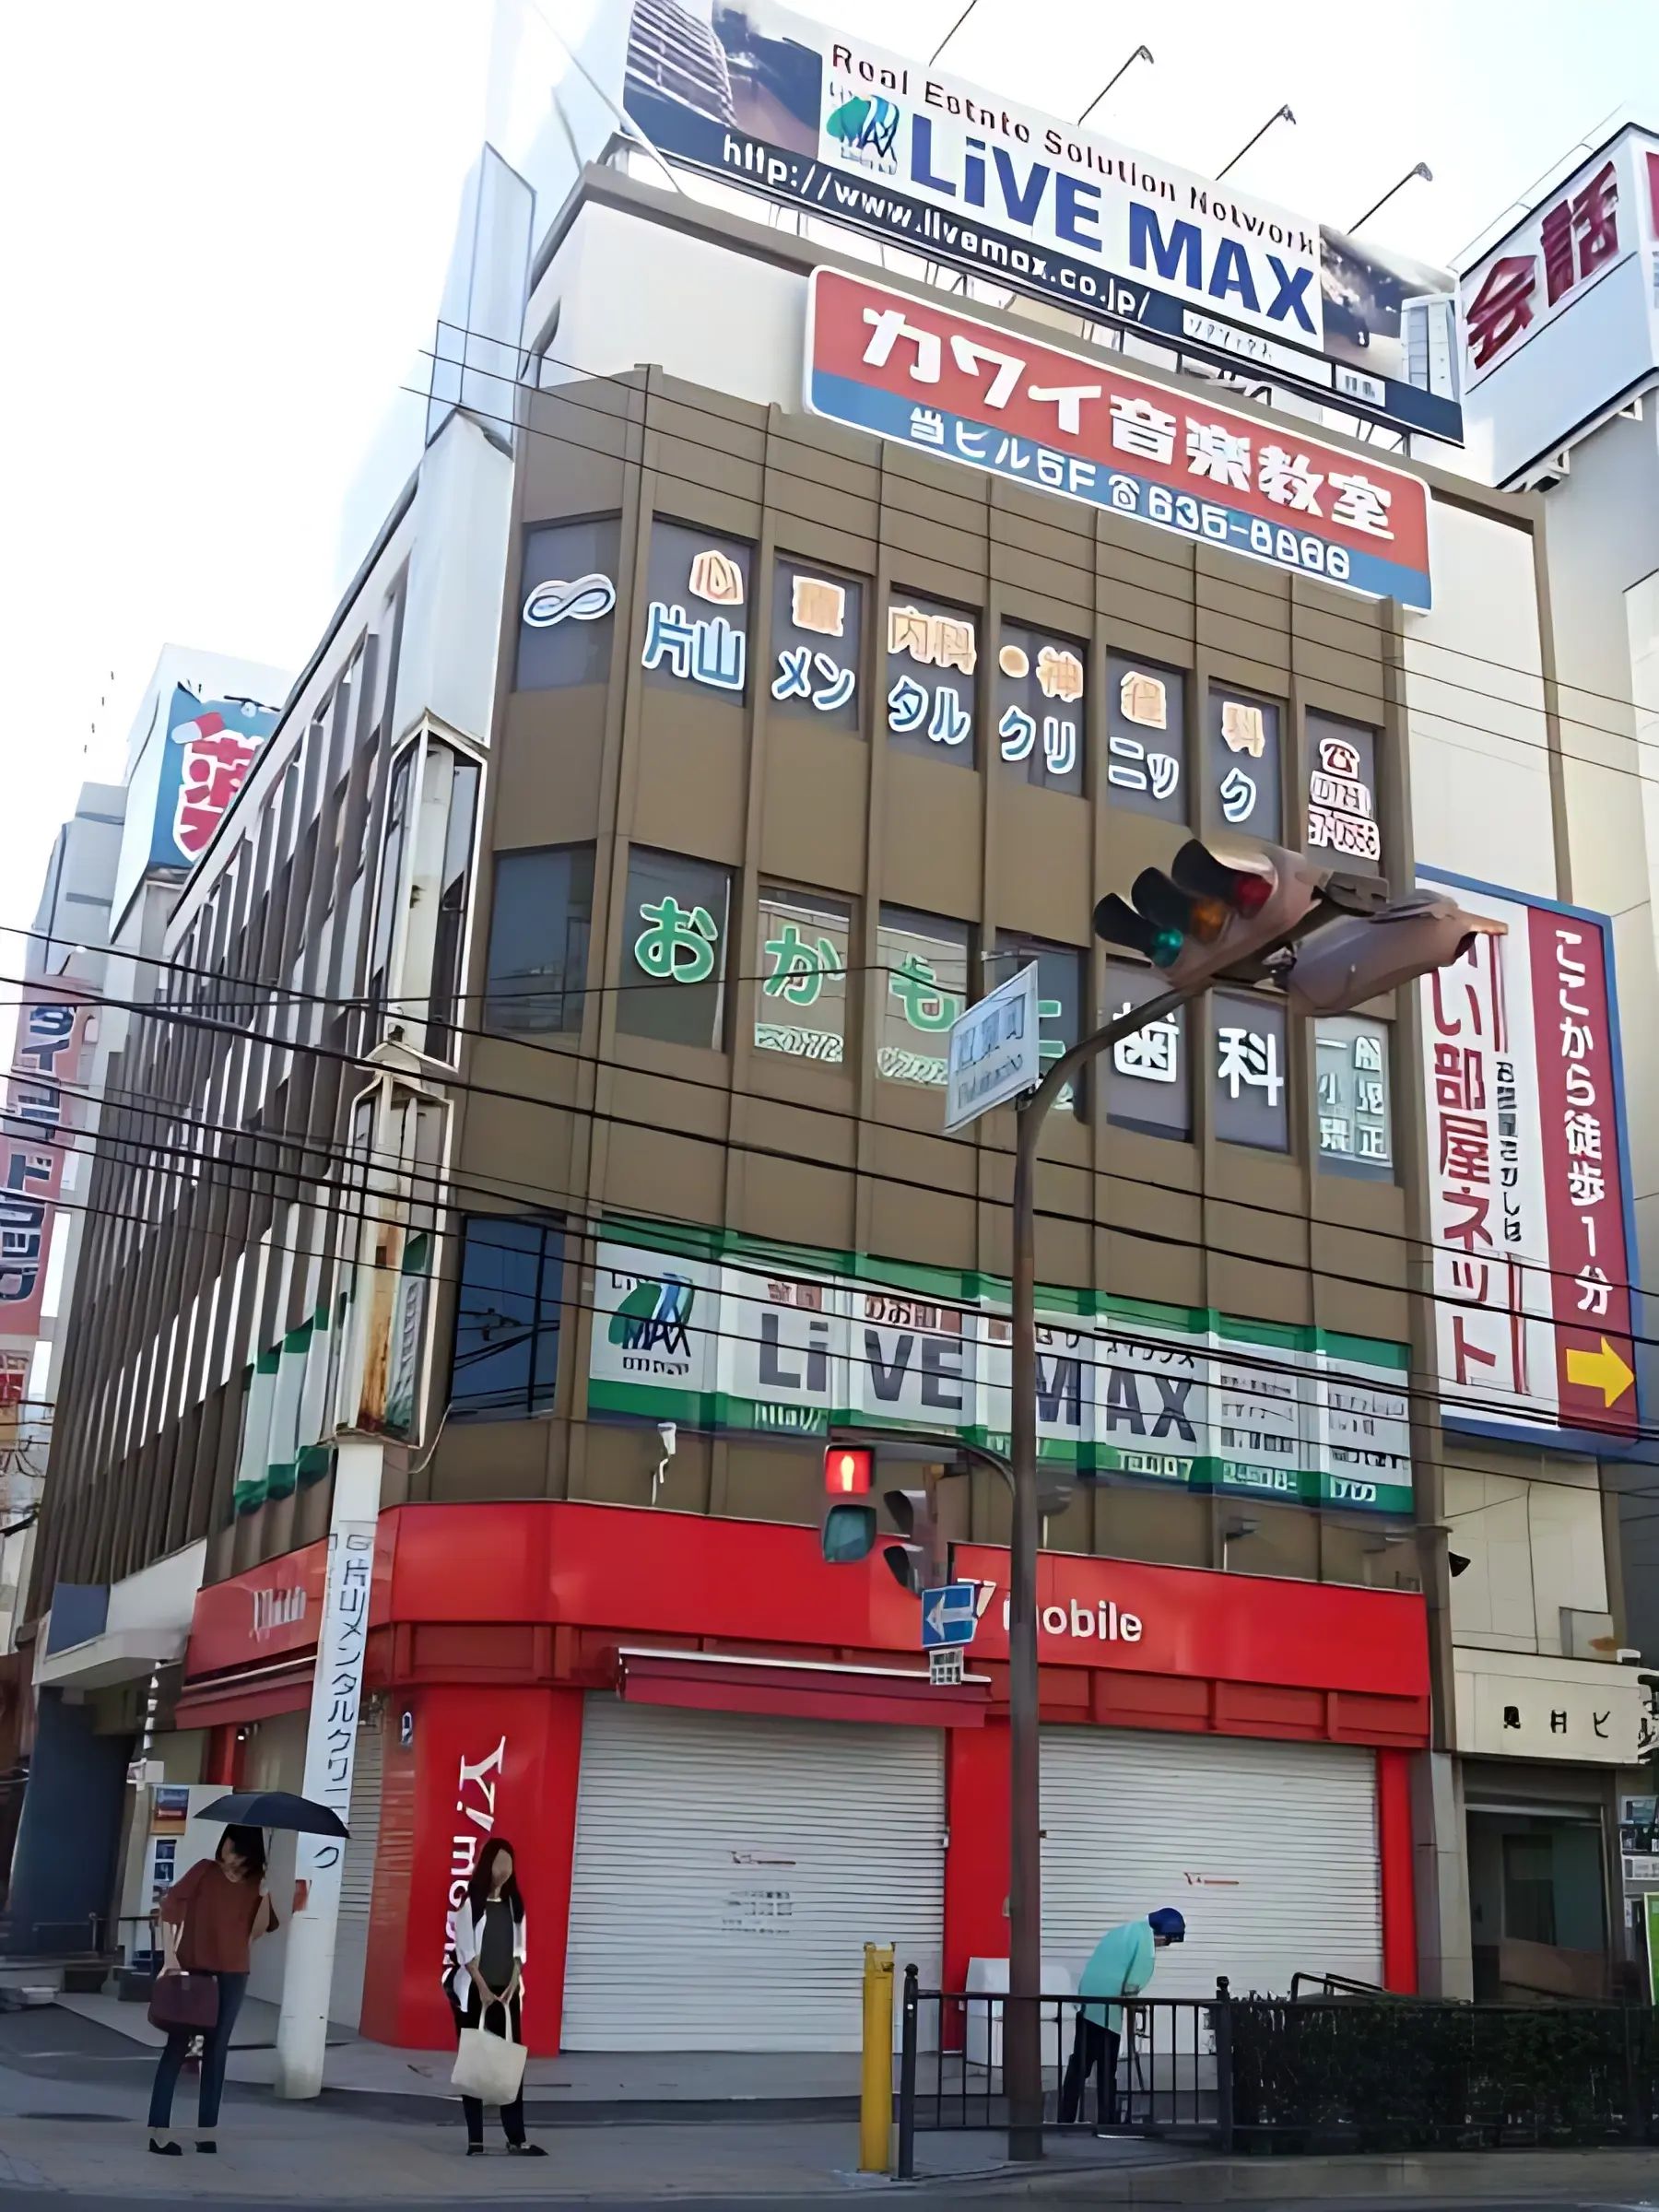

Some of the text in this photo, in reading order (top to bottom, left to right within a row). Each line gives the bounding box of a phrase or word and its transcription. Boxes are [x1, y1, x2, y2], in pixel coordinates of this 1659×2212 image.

[1129, 201, 1318, 336] MAX
[862, 307, 1396, 542] カワイ音楽教室
[1430, 937, 1498, 1385] い部屋ネット
